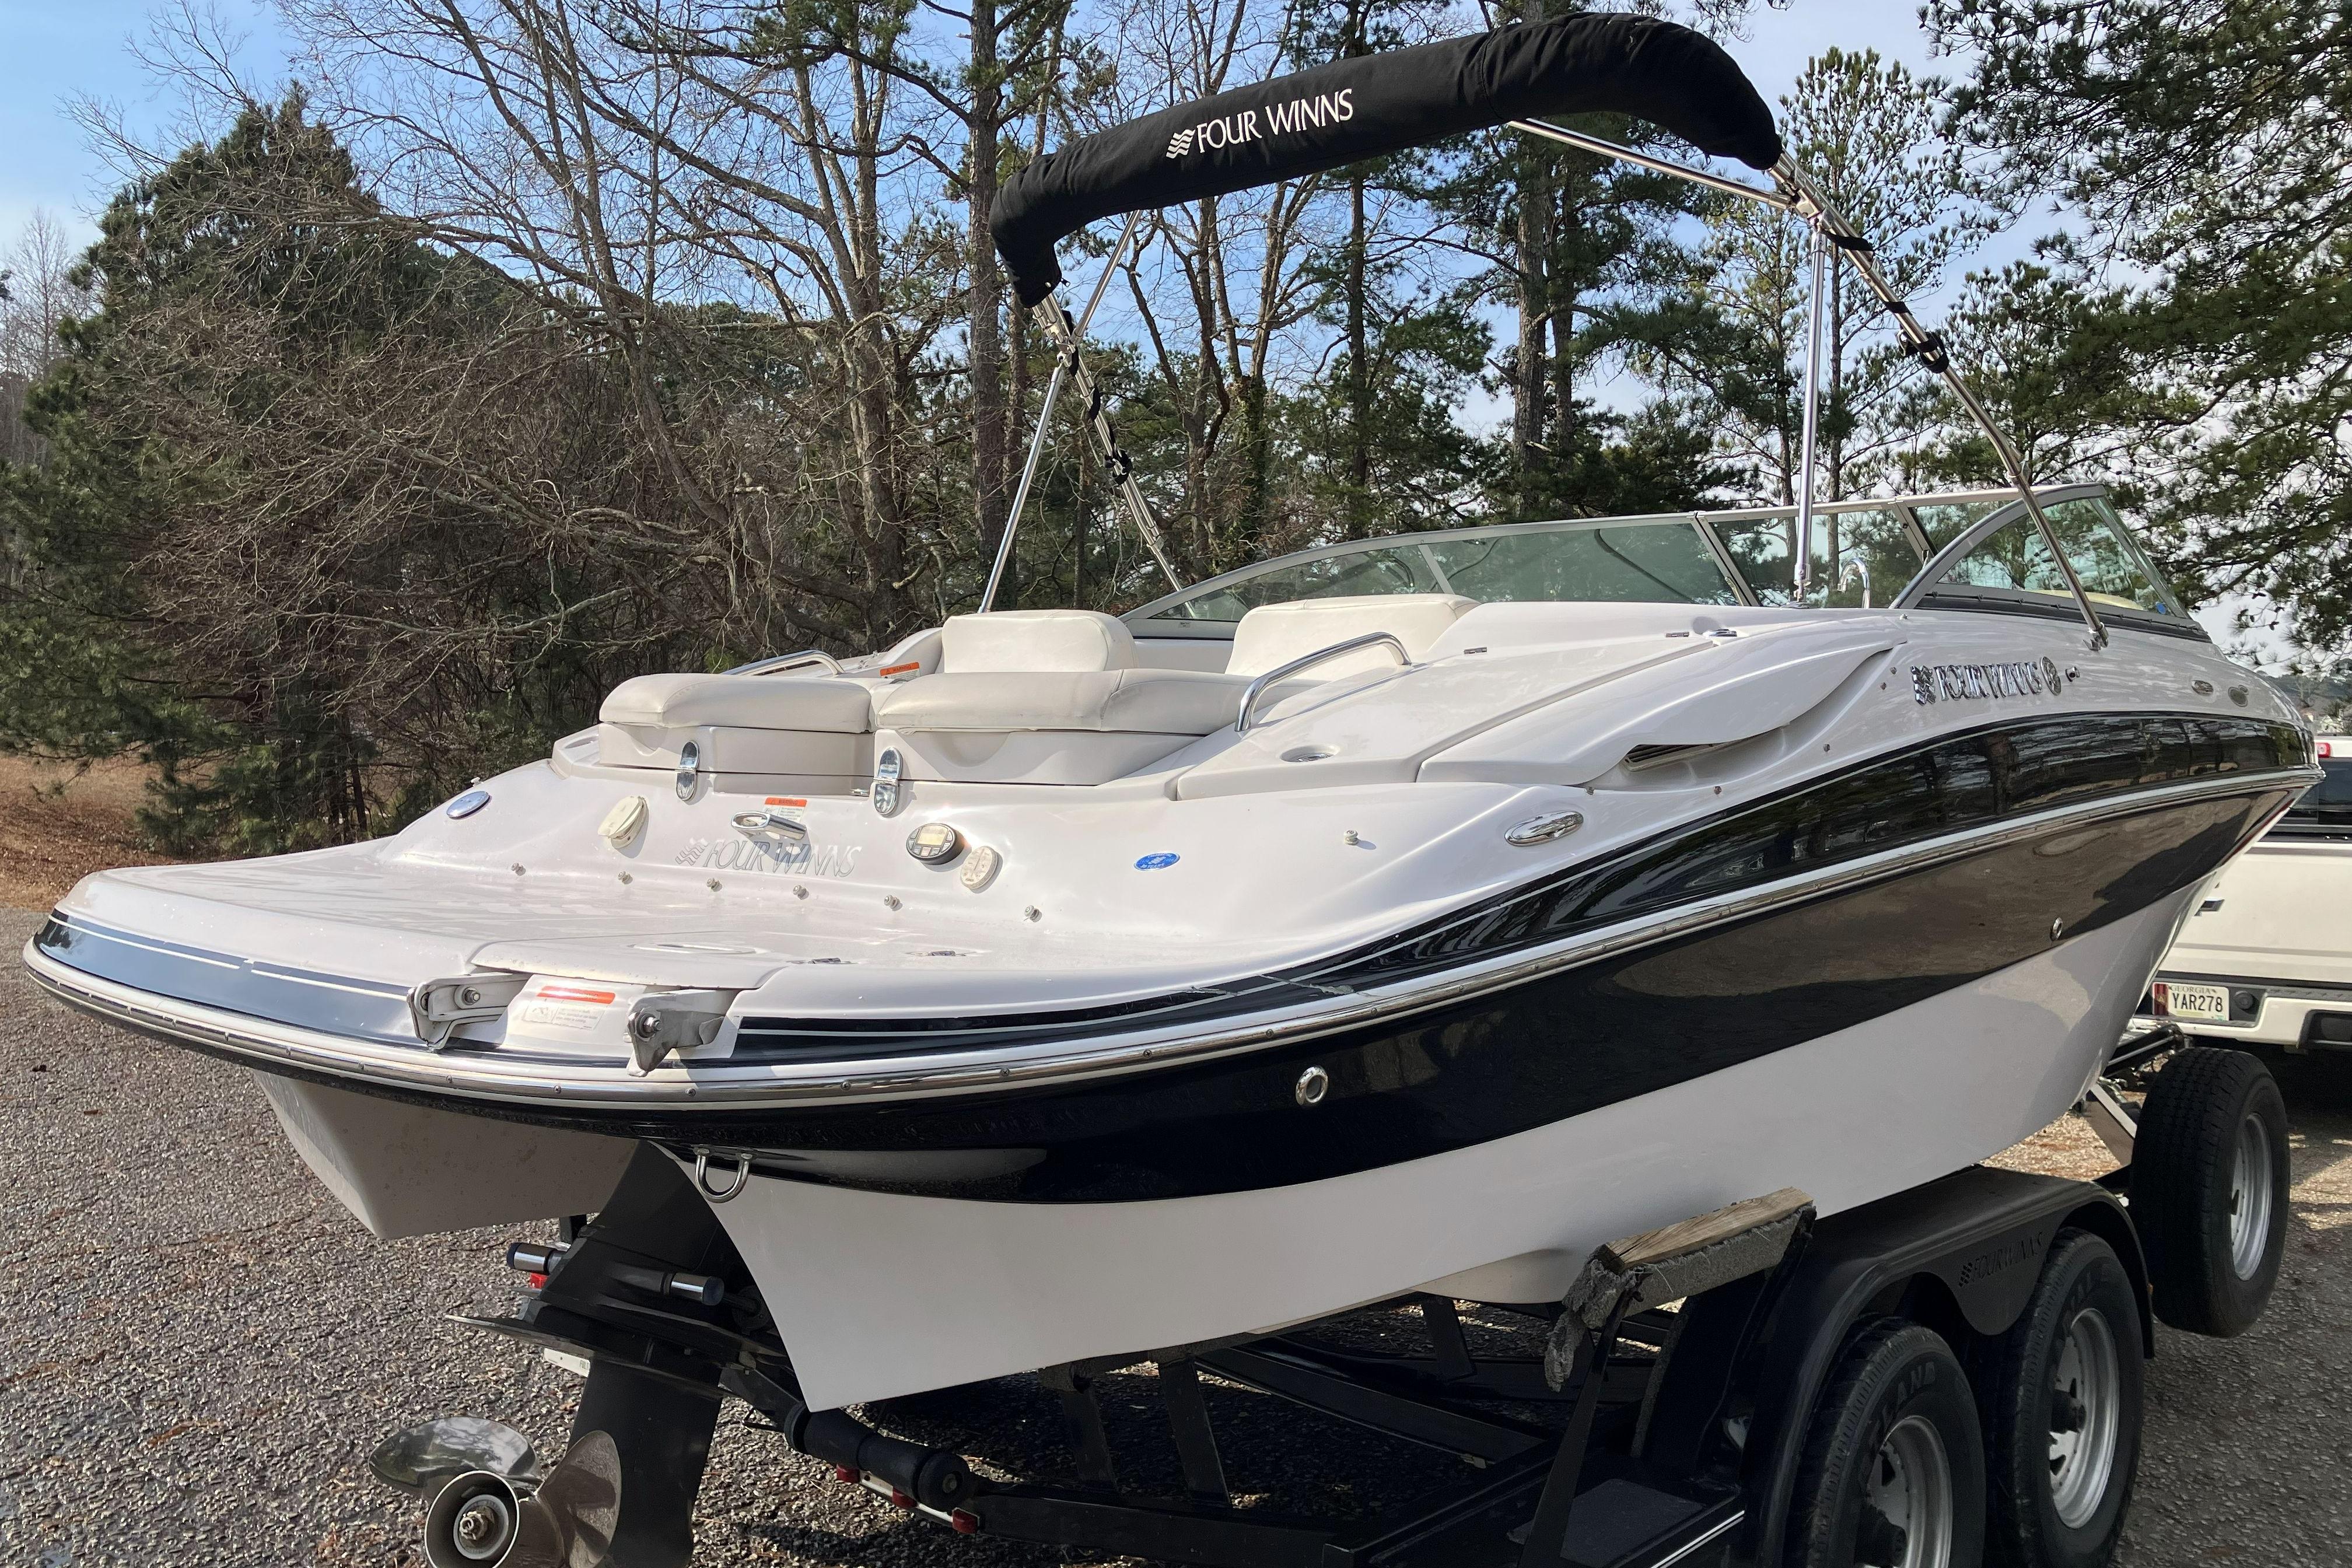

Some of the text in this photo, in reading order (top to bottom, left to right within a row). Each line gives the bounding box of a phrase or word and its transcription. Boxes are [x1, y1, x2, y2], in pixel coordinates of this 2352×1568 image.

[1196, 88, 1353, 153] FOUR WINNS
[1934, 664, 1990, 701] FOUR
[702, 839, 863, 877] FOUR WINNS
[2171, 985, 2211, 995] GEORGIA
[2172, 993, 2223, 1013] YAR278
